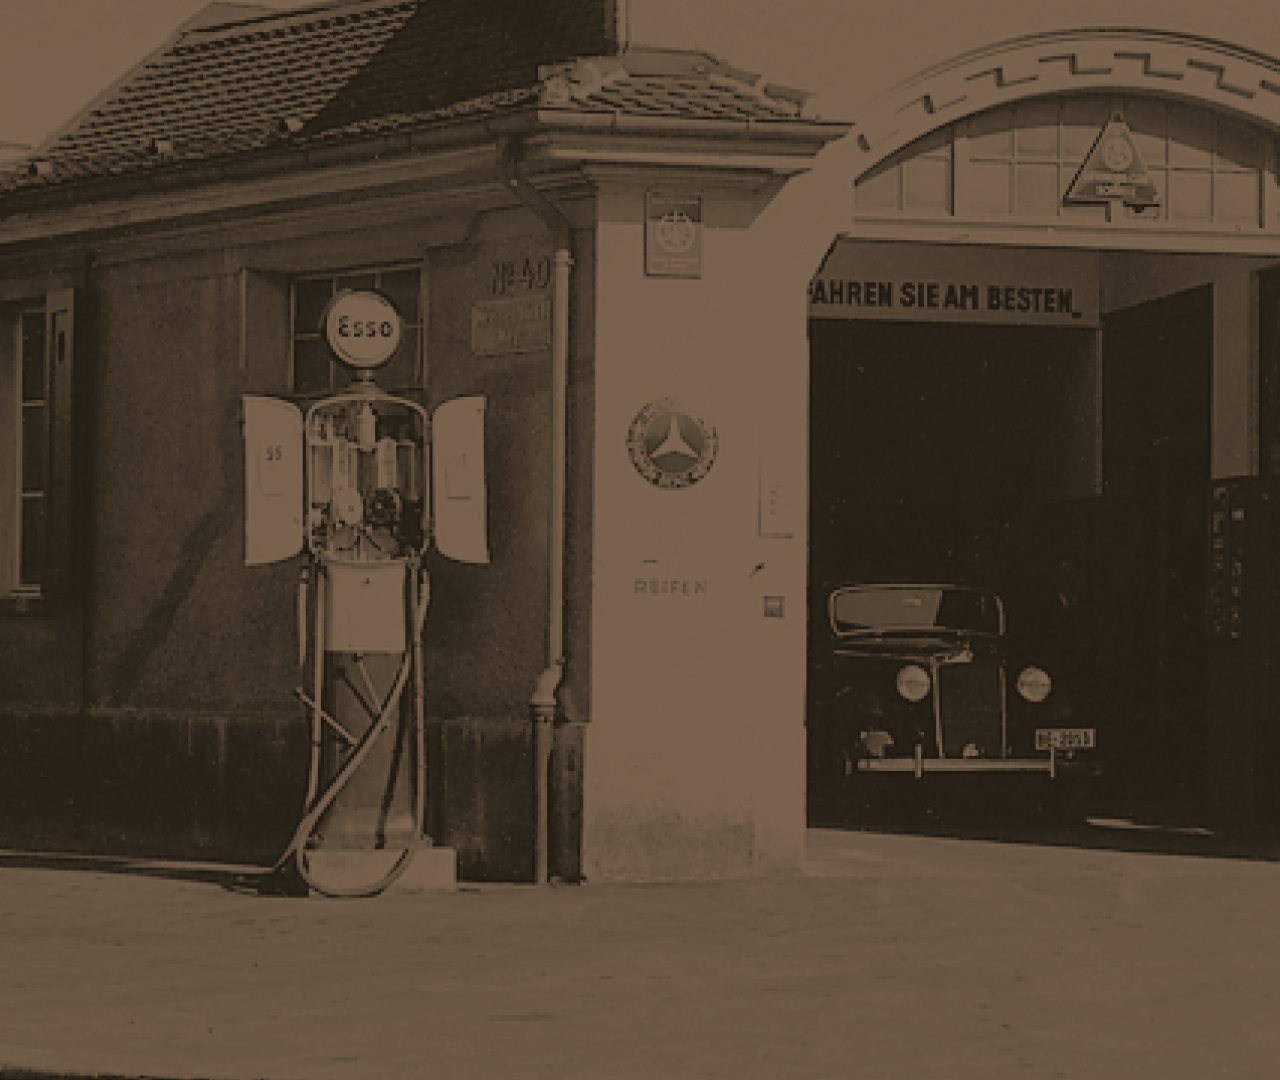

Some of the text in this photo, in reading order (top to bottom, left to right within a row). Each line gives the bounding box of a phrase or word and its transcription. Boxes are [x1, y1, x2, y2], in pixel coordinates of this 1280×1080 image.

[808, 279, 893, 307] AHREN
[900, 282, 939, 308] SIE
[943, 284, 979, 311] AM
